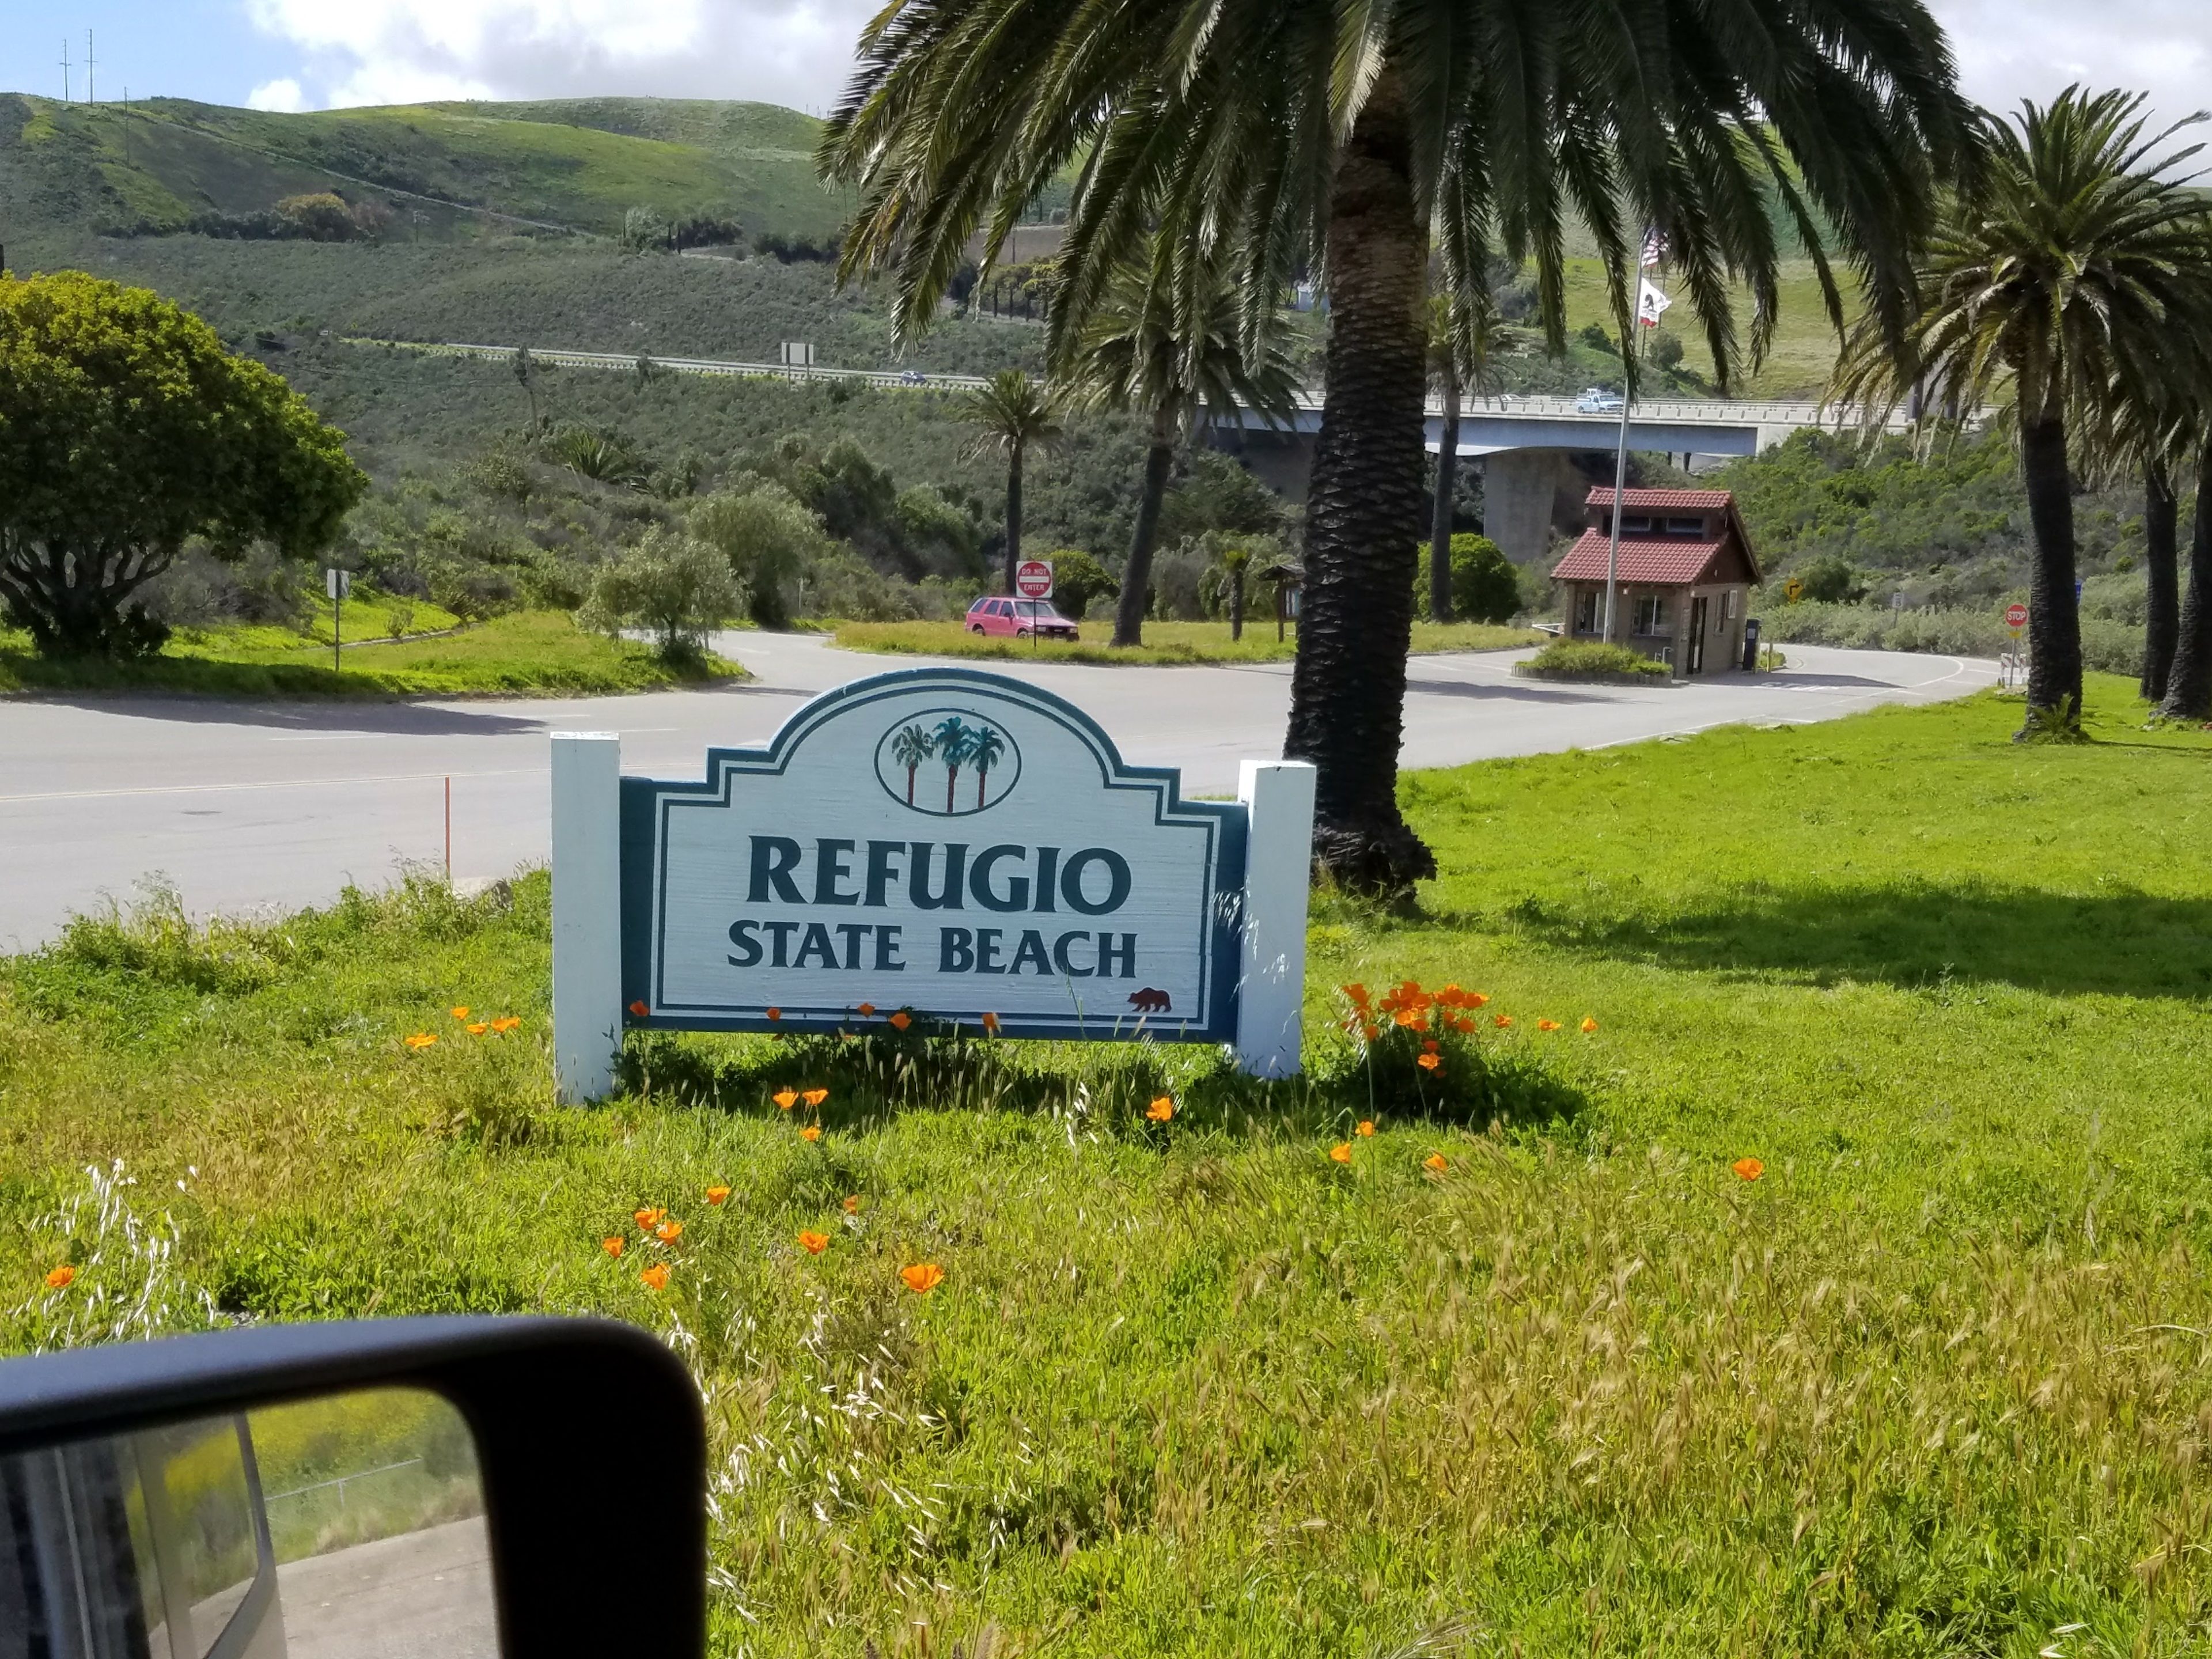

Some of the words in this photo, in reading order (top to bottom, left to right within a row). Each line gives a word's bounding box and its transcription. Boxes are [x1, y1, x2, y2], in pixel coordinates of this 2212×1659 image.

[2007, 611, 2026, 620] STOP
[746, 835, 1132, 915] REFUGIO
[727, 919, 906, 971] STATE
[937, 927, 1138, 978] BEACH
